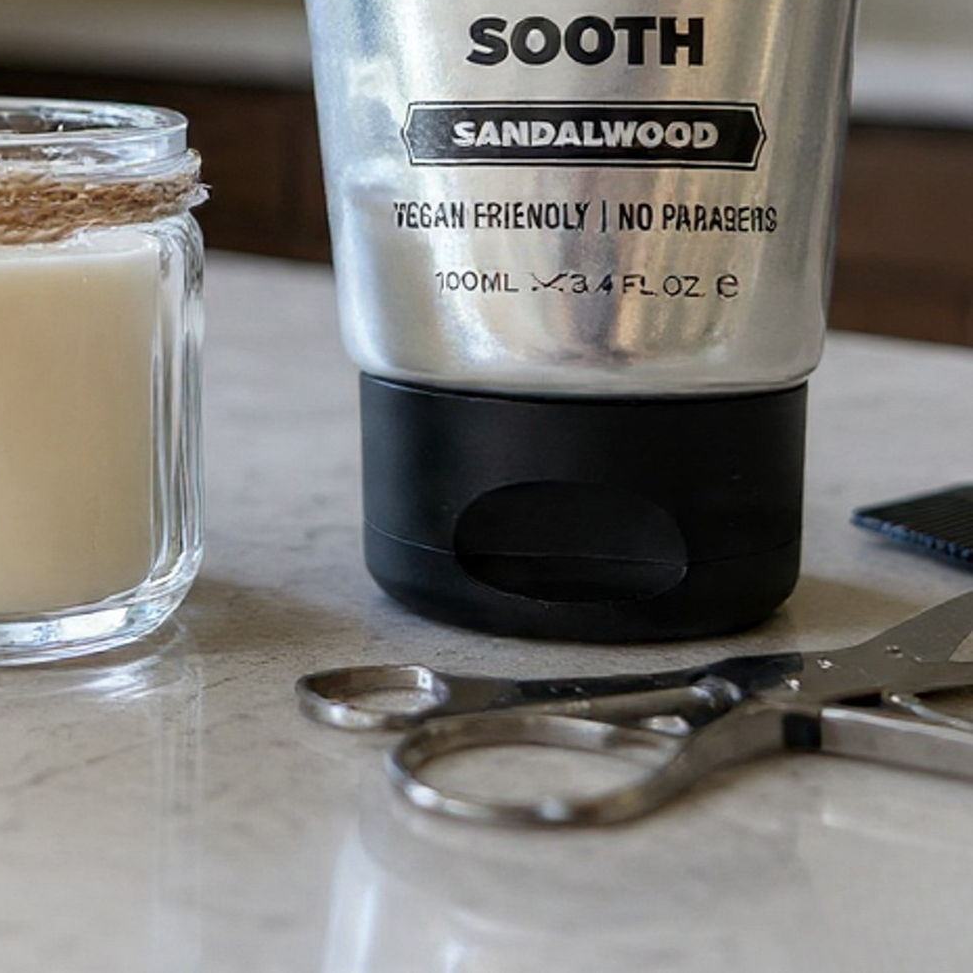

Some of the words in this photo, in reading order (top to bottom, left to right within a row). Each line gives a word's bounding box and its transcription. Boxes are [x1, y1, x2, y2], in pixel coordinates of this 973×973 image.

[466, 15, 705, 67] SOOTH
[453, 120, 719, 149] SANDALWOOD
[474, 201, 591, 231] FRIENDLY
[619, 203, 654, 231] NO
[436, 270, 519, 294] 100ML
